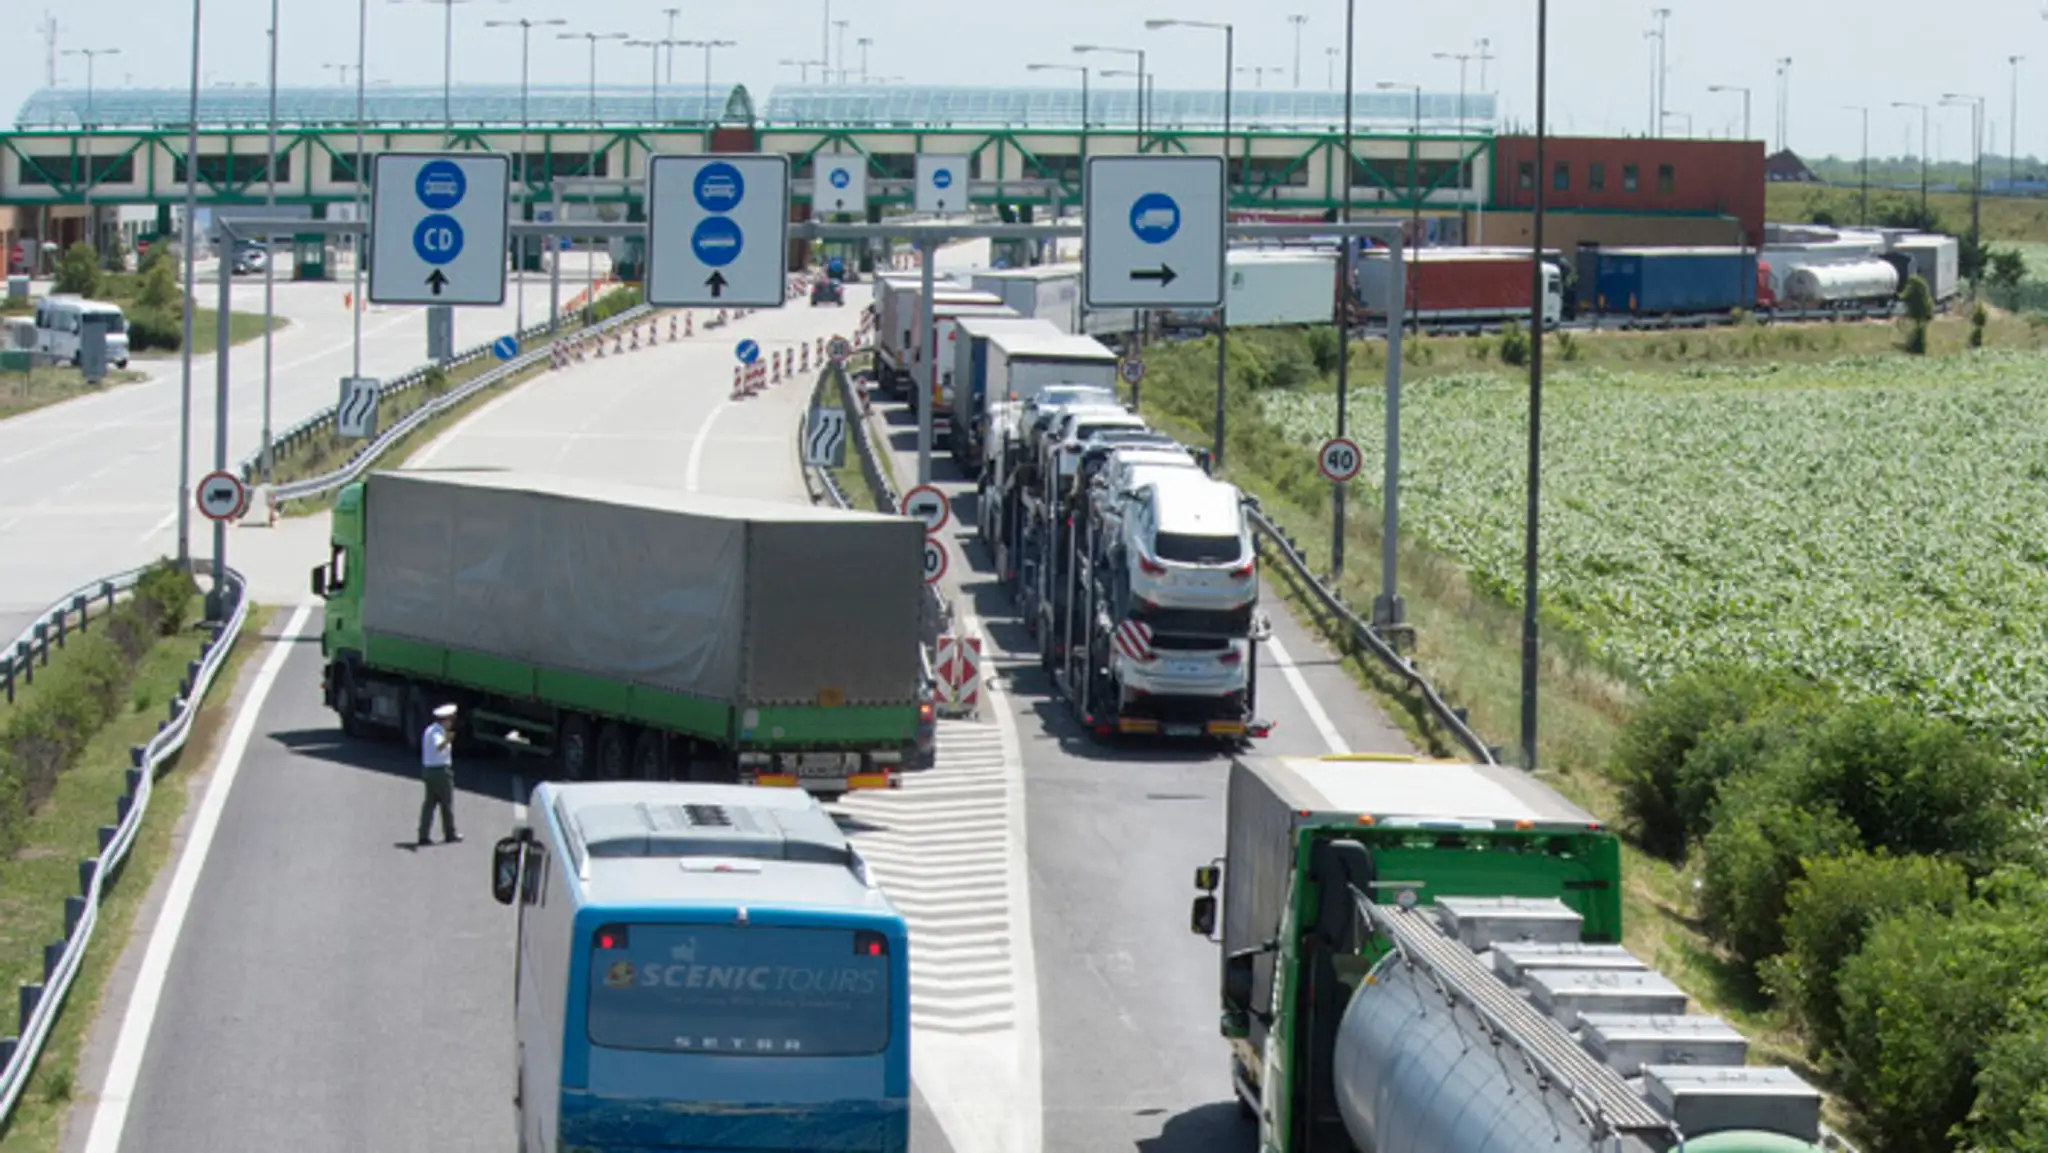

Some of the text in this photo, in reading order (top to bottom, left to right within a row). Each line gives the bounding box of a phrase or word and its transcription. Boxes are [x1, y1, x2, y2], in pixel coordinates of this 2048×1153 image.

[424, 227, 453, 250] CD
[1328, 450, 1353, 470] 40
[924, 549, 938, 572] 0
[641, 963, 879, 994] SCENIC TOURS
